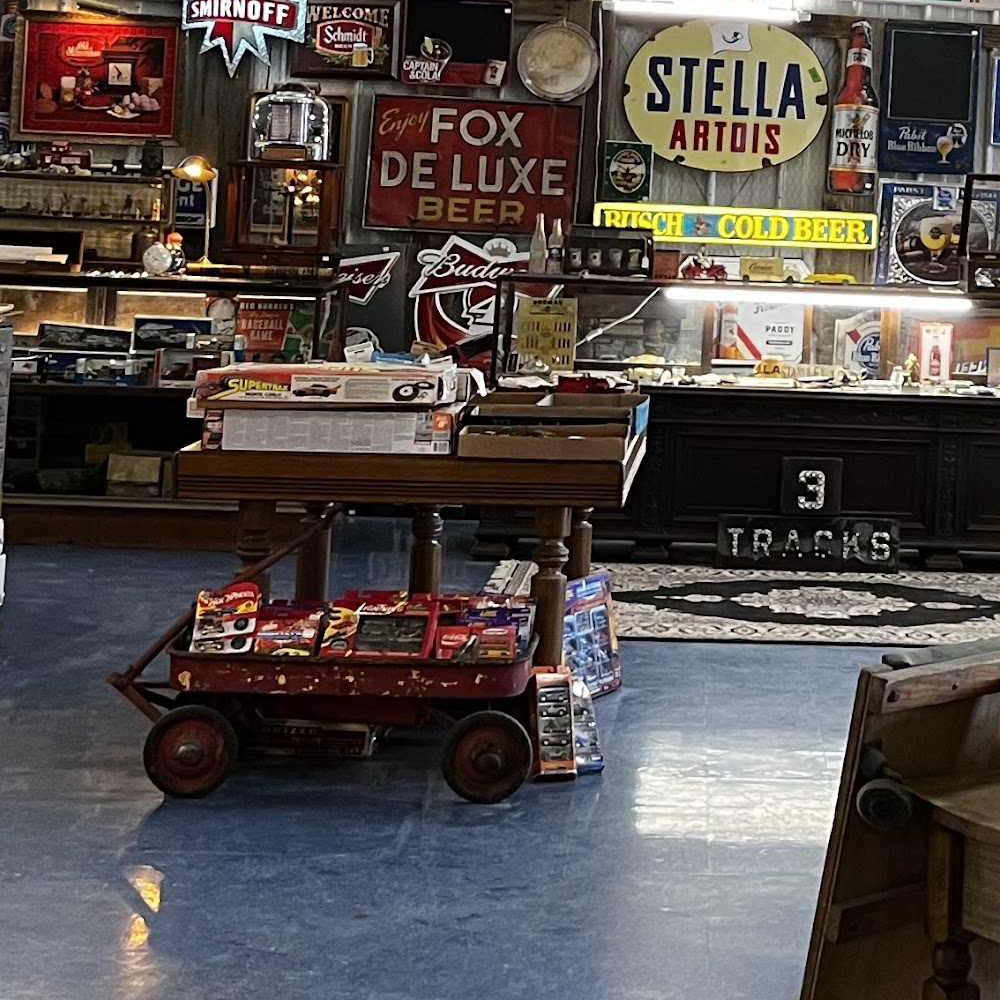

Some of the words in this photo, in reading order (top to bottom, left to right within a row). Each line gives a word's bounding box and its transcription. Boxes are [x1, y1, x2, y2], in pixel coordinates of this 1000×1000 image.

[306, 4, 390, 29] WELCOME
[323, 24, 368, 44] Schmidt
[402, 59, 440, 72] CAPTAIN
[646, 55, 806, 120] STELLA
[378, 108, 431, 141] Enjoy
[430, 107, 525, 148] FOX
[669, 118, 781, 155] ARTOIS
[898, 126, 927, 141] Pabst
[836, 141, 871, 158] DRY
[887, 140, 907, 151] Blue
[907, 141, 938, 152] Ribbon
[379, 150, 438, 190] DE
[450, 153, 567, 196] LUXE
[417, 196, 526, 225] BEER
[603, 208, 684, 236] BUSCH
[717, 214, 789, 240] COLD
[792, 218, 870, 244] BEER
[239, 318, 285, 331] BASEBALL
[228, 378, 289, 392] SUPERTRAX
[797, 470, 826, 510] 3
[727, 527, 891, 561] TRACKS
